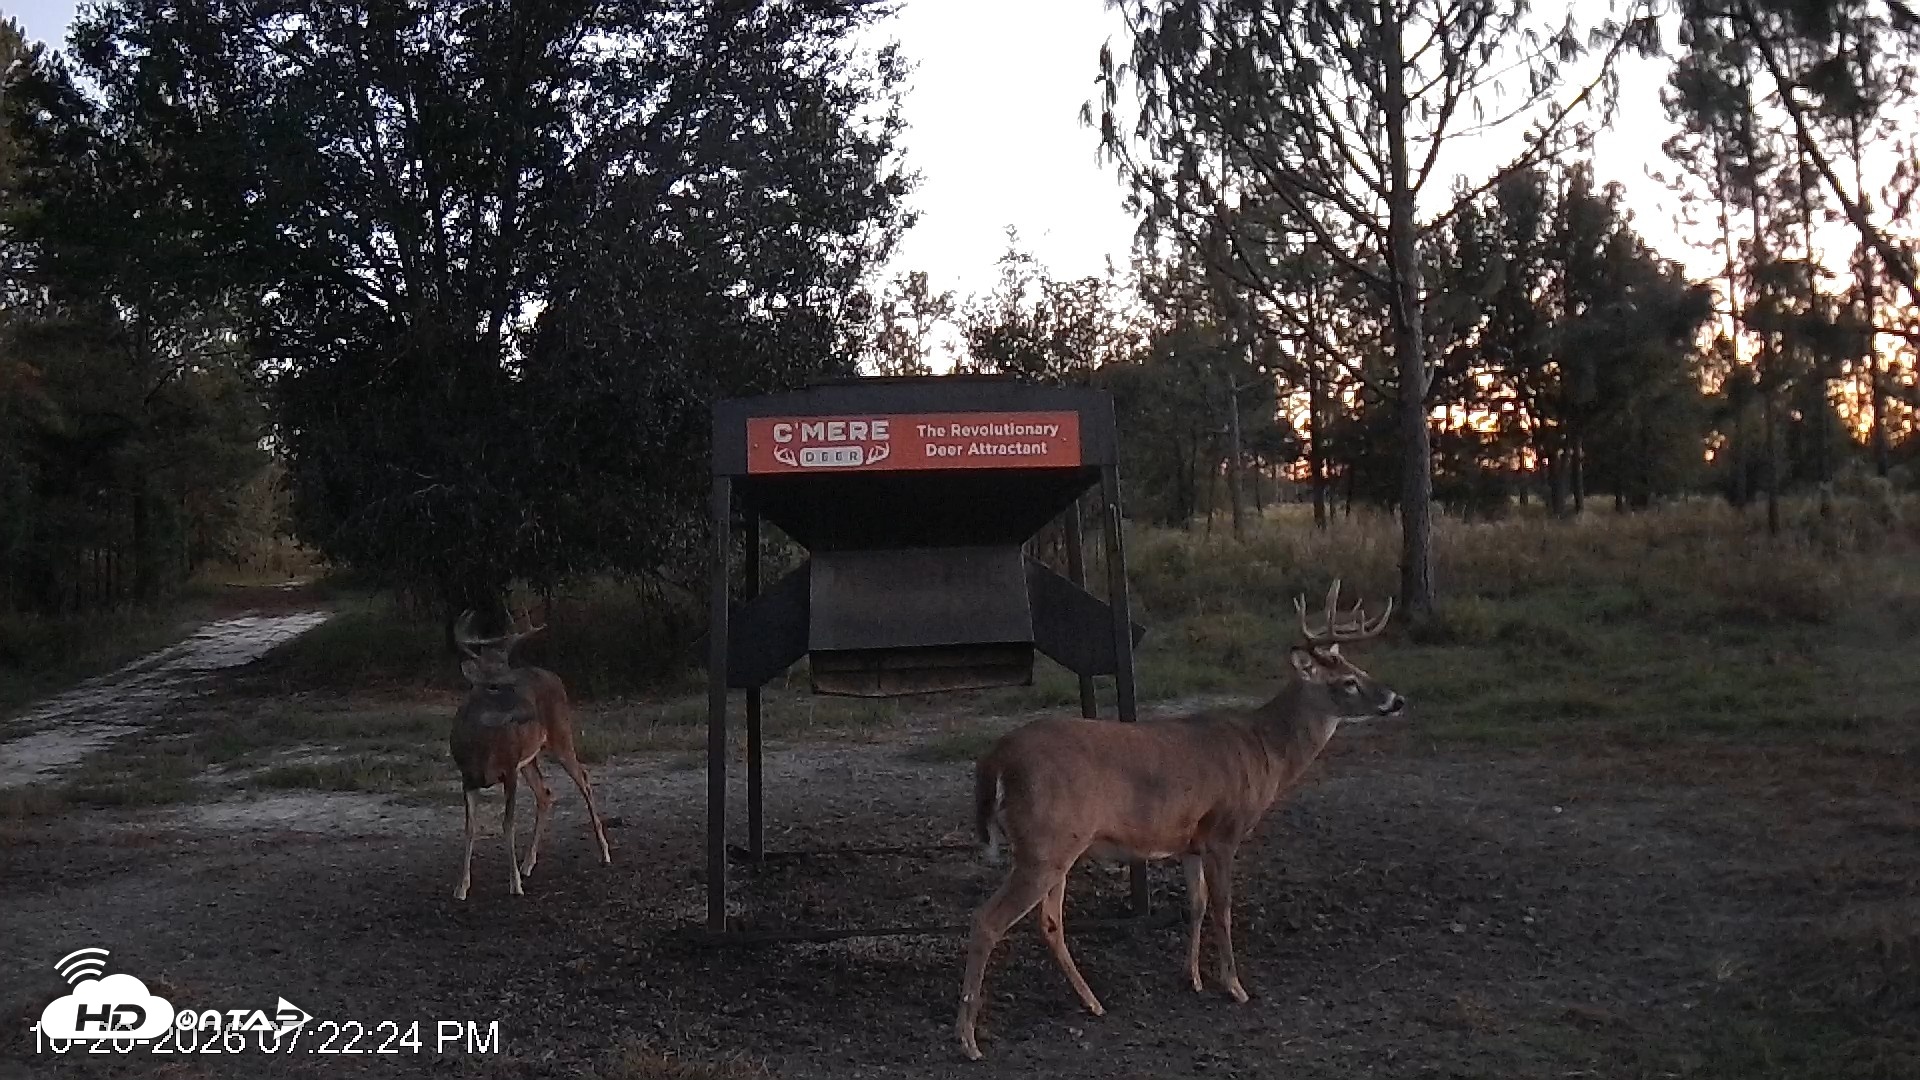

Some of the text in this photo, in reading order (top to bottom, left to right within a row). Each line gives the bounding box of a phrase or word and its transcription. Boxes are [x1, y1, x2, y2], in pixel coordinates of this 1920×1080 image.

[773, 421, 890, 442] C'MERE
[917, 422, 1060, 438] The Revolutionary
[804, 450, 859, 462] DEER
[926, 439, 1048, 457] Deer Attractant
